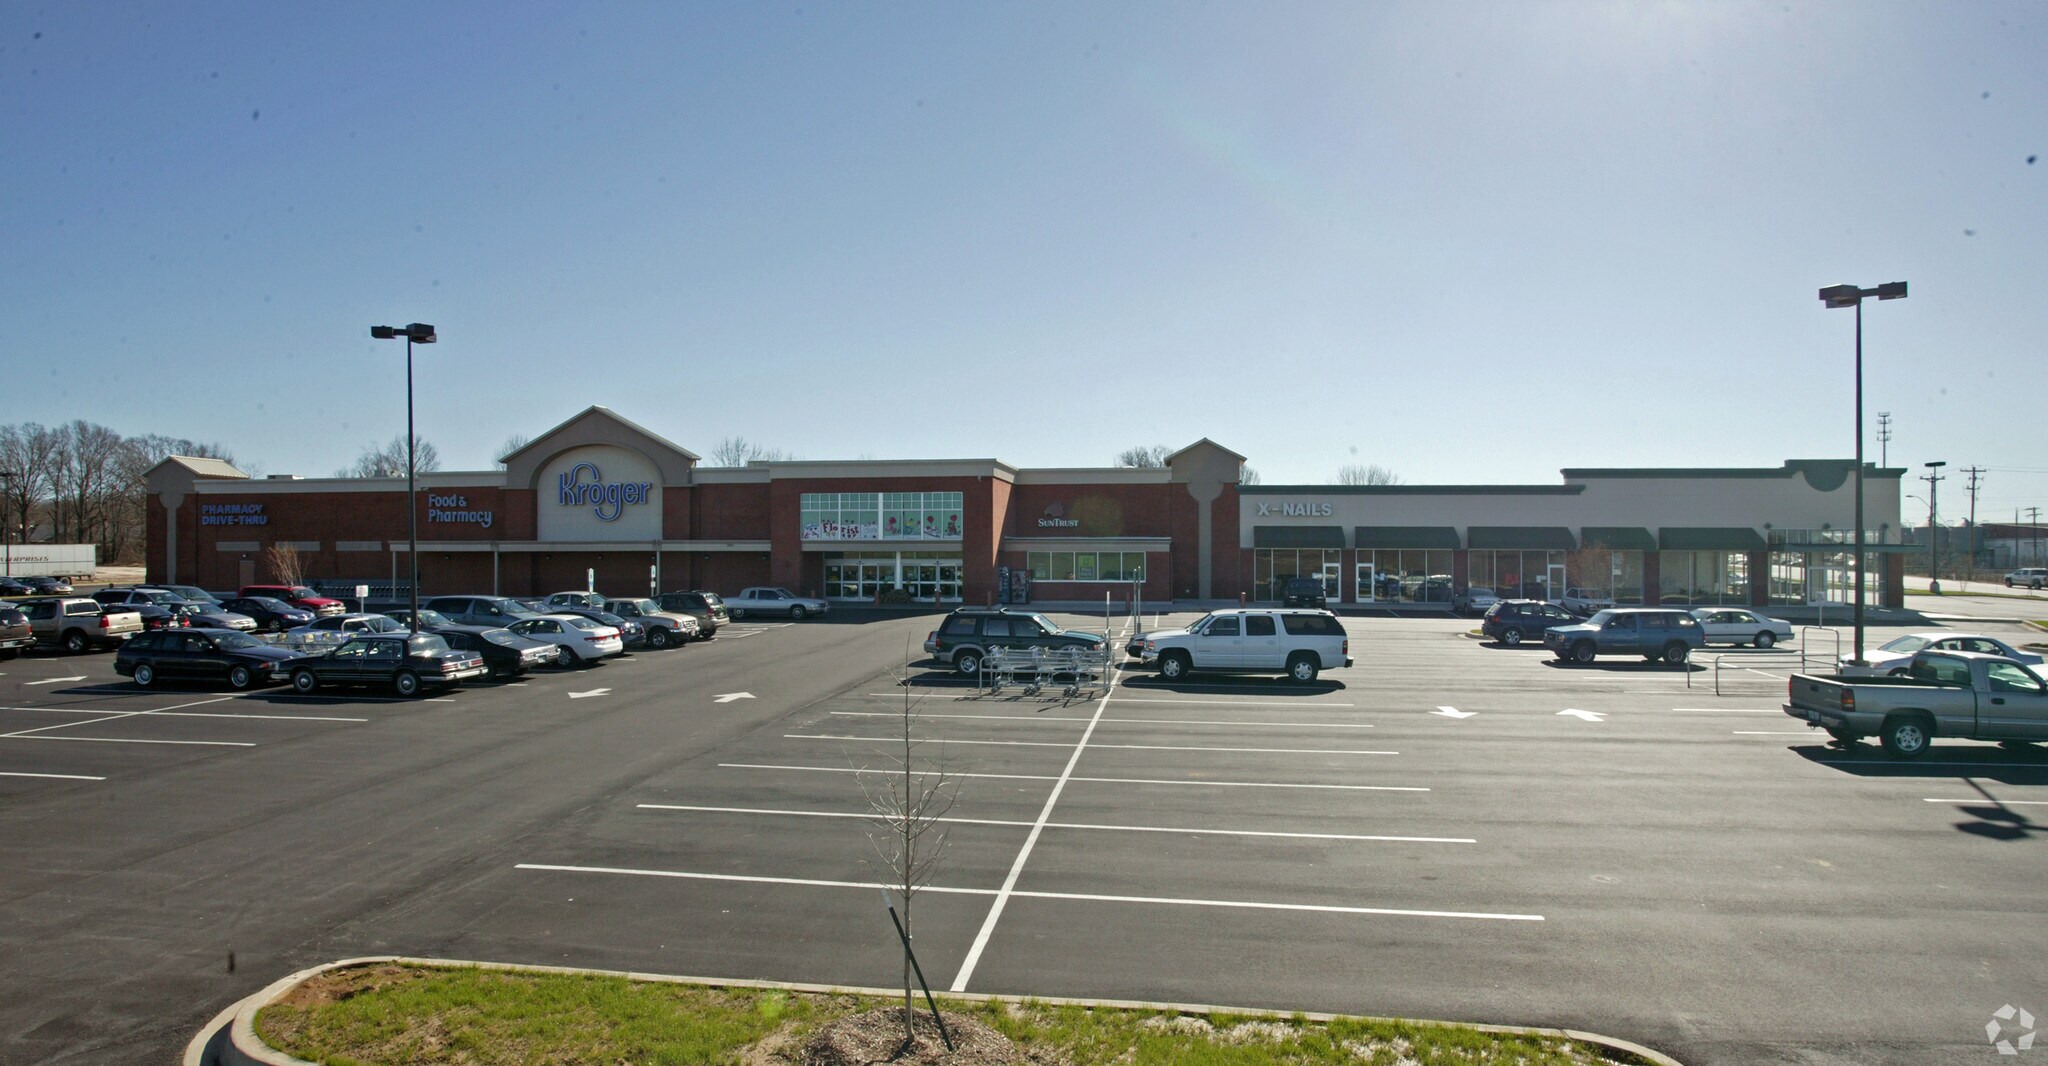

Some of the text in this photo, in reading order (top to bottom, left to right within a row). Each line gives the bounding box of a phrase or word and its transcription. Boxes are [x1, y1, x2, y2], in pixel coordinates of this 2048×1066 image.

[559, 462, 651, 522] Kroger
[428, 494, 467, 507] Food &
[202, 504, 264, 514] PHARMACY
[202, 515, 268, 525] DRIVE-THRU
[428, 508, 493, 528] Pharmacy
